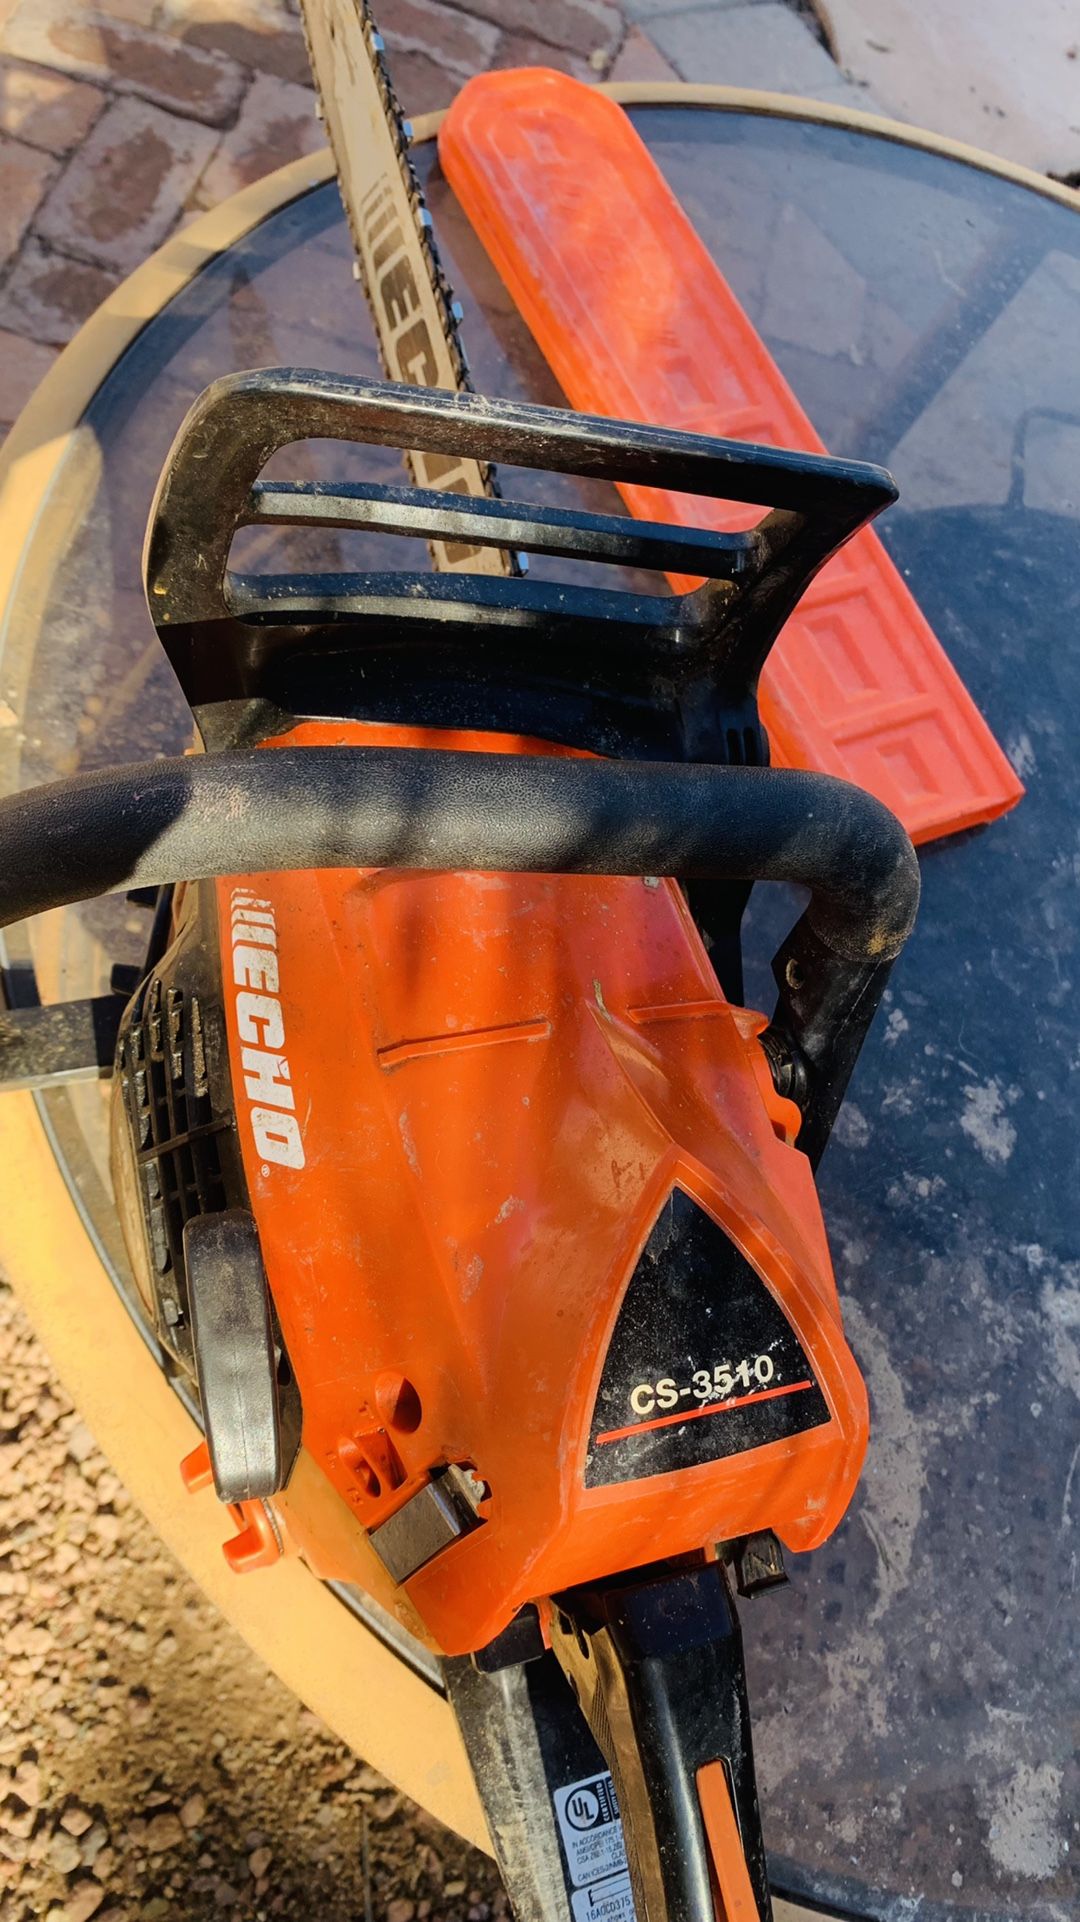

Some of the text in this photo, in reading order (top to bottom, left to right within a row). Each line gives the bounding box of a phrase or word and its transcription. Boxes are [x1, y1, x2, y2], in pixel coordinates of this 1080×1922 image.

[232, 945, 306, 1170] ECHO
[630, 1354, 774, 1415] CS-3510
[571, 1797, 595, 1821] UL
